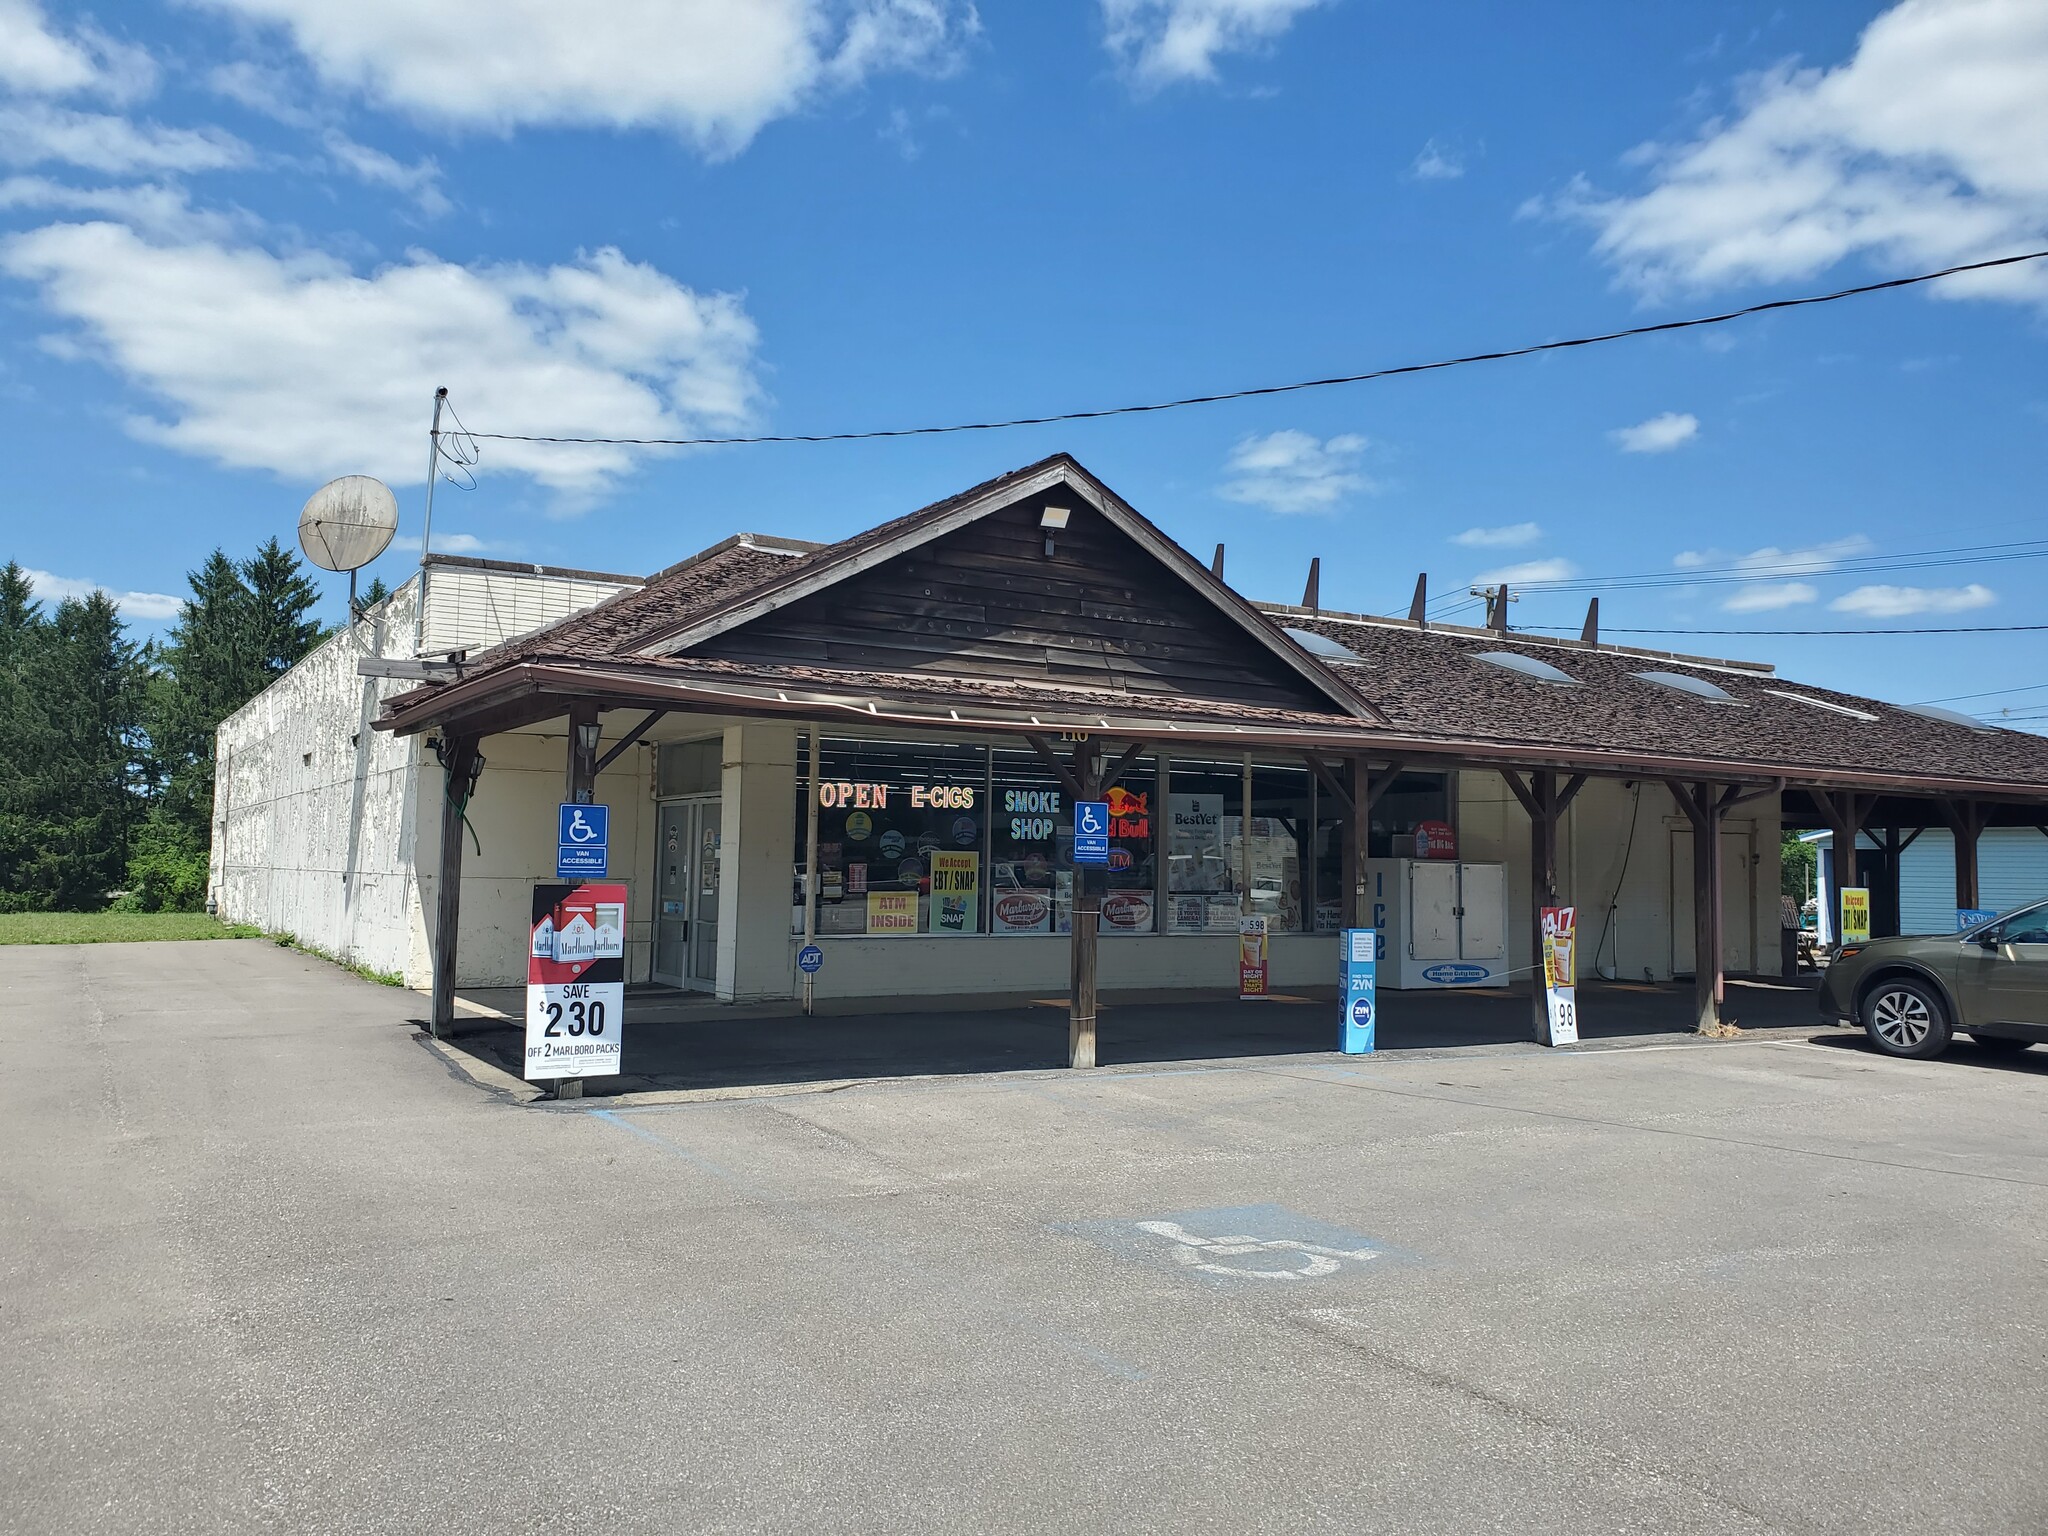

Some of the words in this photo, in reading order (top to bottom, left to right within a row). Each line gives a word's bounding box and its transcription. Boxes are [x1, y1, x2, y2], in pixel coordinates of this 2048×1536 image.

[819, 782, 888, 809] OPEN
[911, 785, 974, 809] E-CIGS
[1005, 789, 1060, 814] SMOKE
[1010, 817, 1054, 840] SHOP
[1118, 818, 1148, 838] Bull
[562, 857, 603, 865] ACCESSIBLE
[939, 858, 949, 867] We
[950, 858, 971, 868] Accept
[879, 897, 906, 910] ATM
[870, 914, 914, 928] INSIDE
[940, 913, 965, 924] SNAP
[1249, 920, 1264, 929] 5.98
[561, 937, 593, 954] Marlboro
[800, 953, 821, 964] ADT
[1352, 979, 1373, 990] ZYN
[562, 985, 590, 999] SAVE
[1354, 1006, 1369, 1015] ZYN
[528, 1047, 542, 1058] OFF
[544, 1043, 551, 1057] 2
[553, 1044, 594, 1056] MARLBORO
[596, 1043, 620, 1054] PACKS
